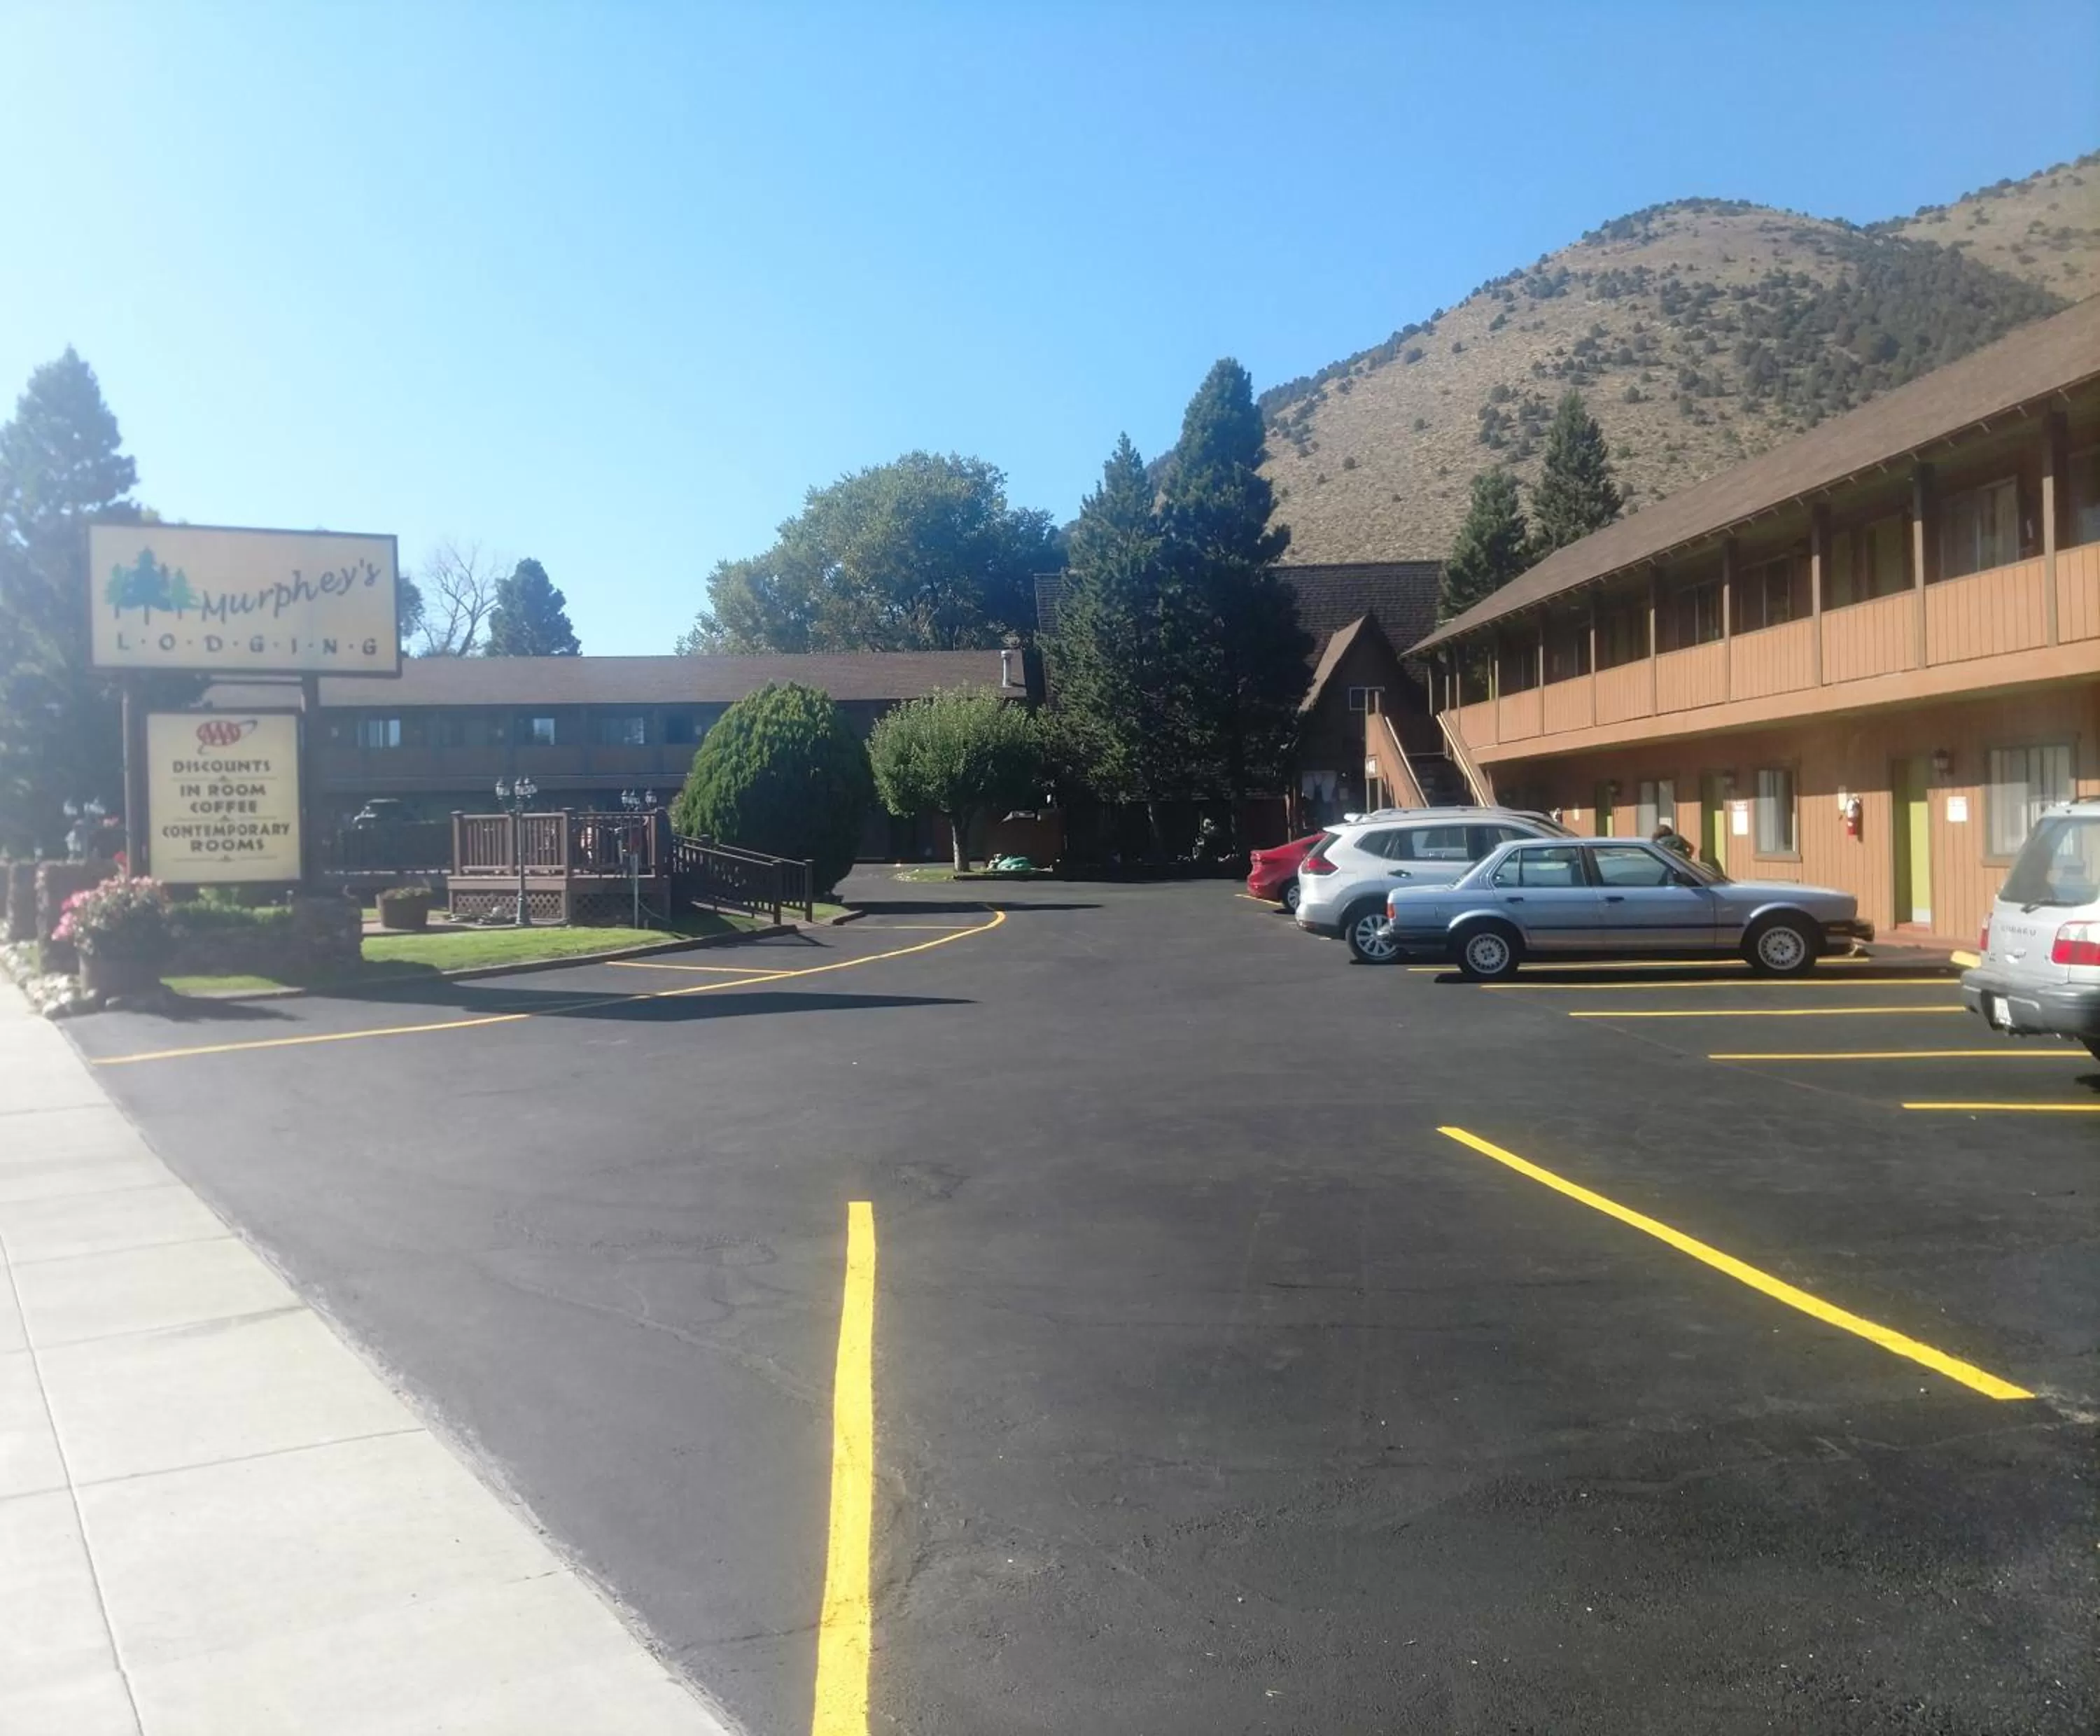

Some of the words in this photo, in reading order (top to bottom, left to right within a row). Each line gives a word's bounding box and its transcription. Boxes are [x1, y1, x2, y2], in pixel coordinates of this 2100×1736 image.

[202, 558, 381, 624] Murphey's
[197, 721, 239, 746] AAA
[173, 760, 271, 773] DISCOUNTS
[181, 784, 200, 797] IN
[208, 784, 267, 796] ROOM
[190, 800, 258, 813] COFFEE
[162, 823, 290, 838] CONTEMPORARY
[190, 839, 265, 852] ROOMS
